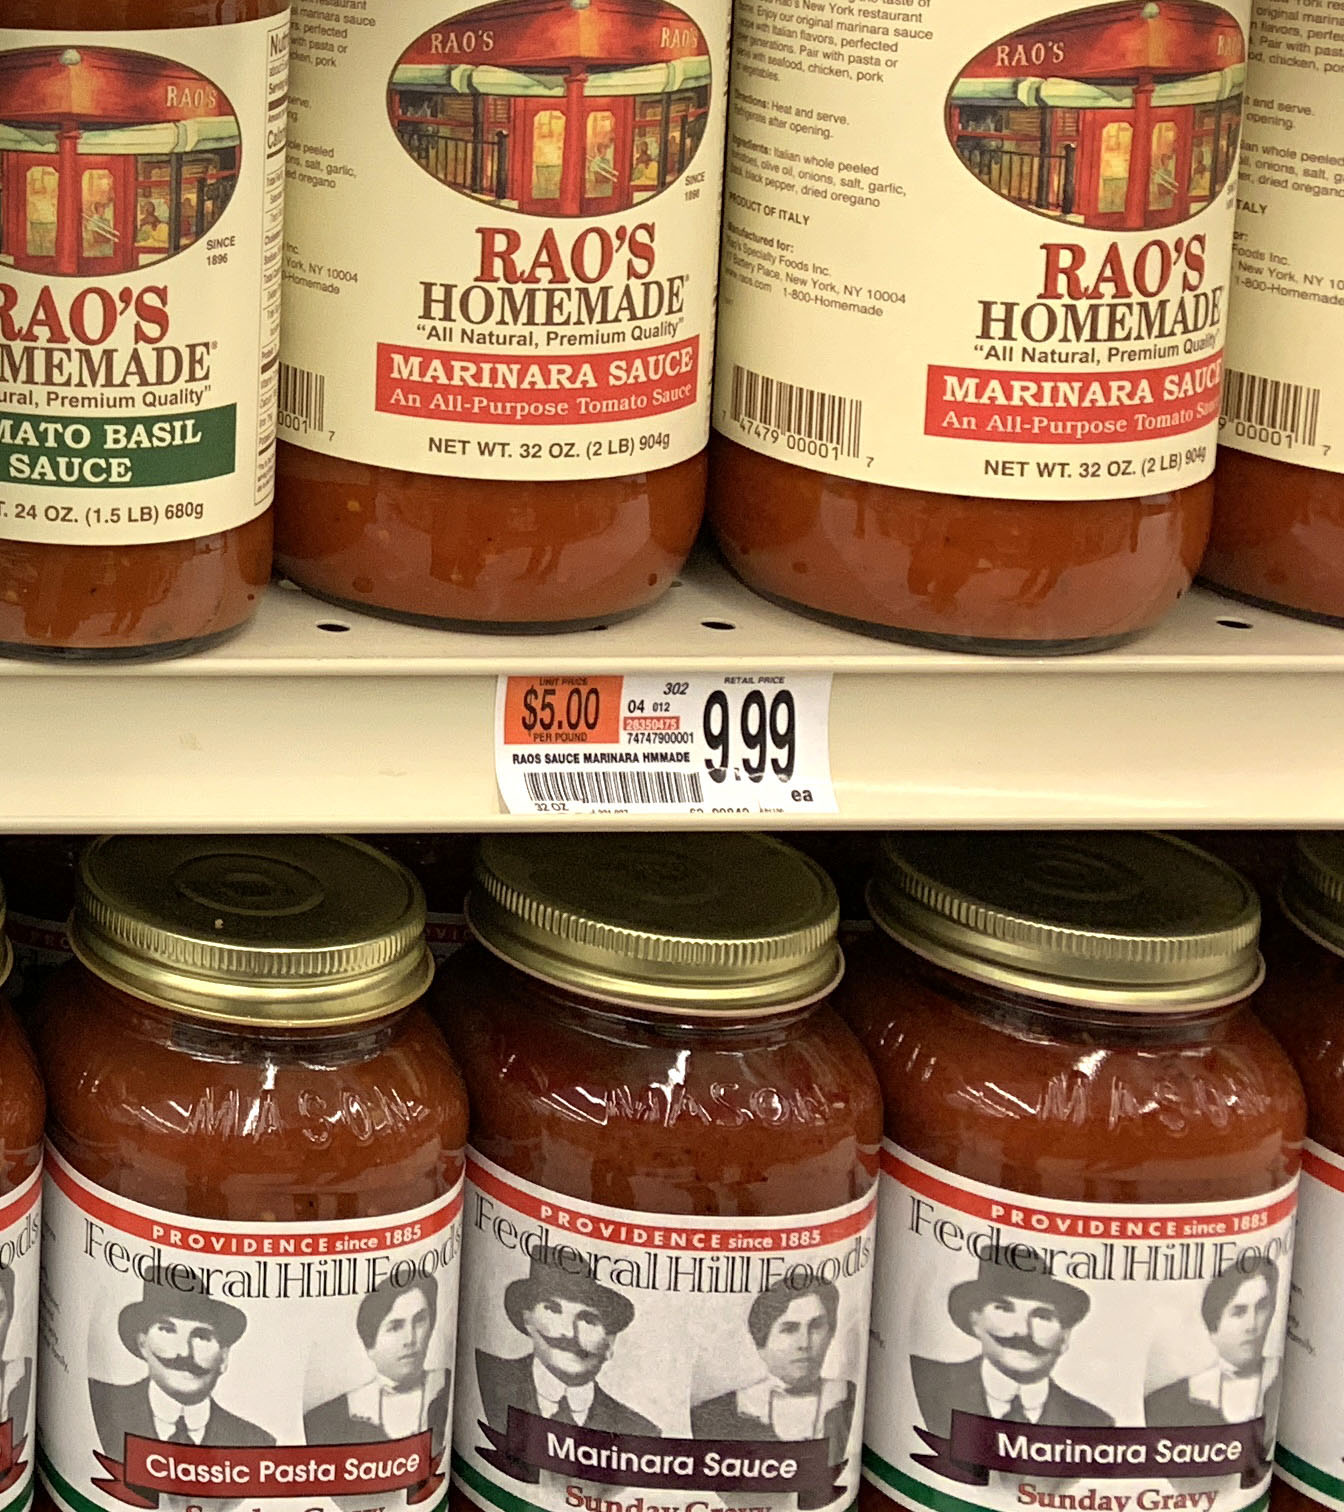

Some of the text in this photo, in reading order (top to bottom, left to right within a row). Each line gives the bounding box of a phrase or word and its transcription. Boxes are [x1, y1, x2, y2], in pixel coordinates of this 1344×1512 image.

[474, 222, 656, 286] RAO'S
[1037, 234, 1206, 301] RAO'S
[419, 277, 685, 327] HOMEMADE
[976, 288, 1223, 344] HOMEMADE
[390, 347, 693, 390] MARINARA SAUCE
[390, 383, 692, 420] An All-Purpose Tomato Sauce
[104, 416, 201, 450] BASIL
[9, 455, 132, 484] SAUCE
[522, 685, 796, 783] $5.00 9.99
[513, 752, 690, 764] RAOS SAUCE MARINARA HMMADE
[547, 1433, 798, 1478] Marinara Sauce
[997, 1434, 1242, 1464] Marinara Sauce
